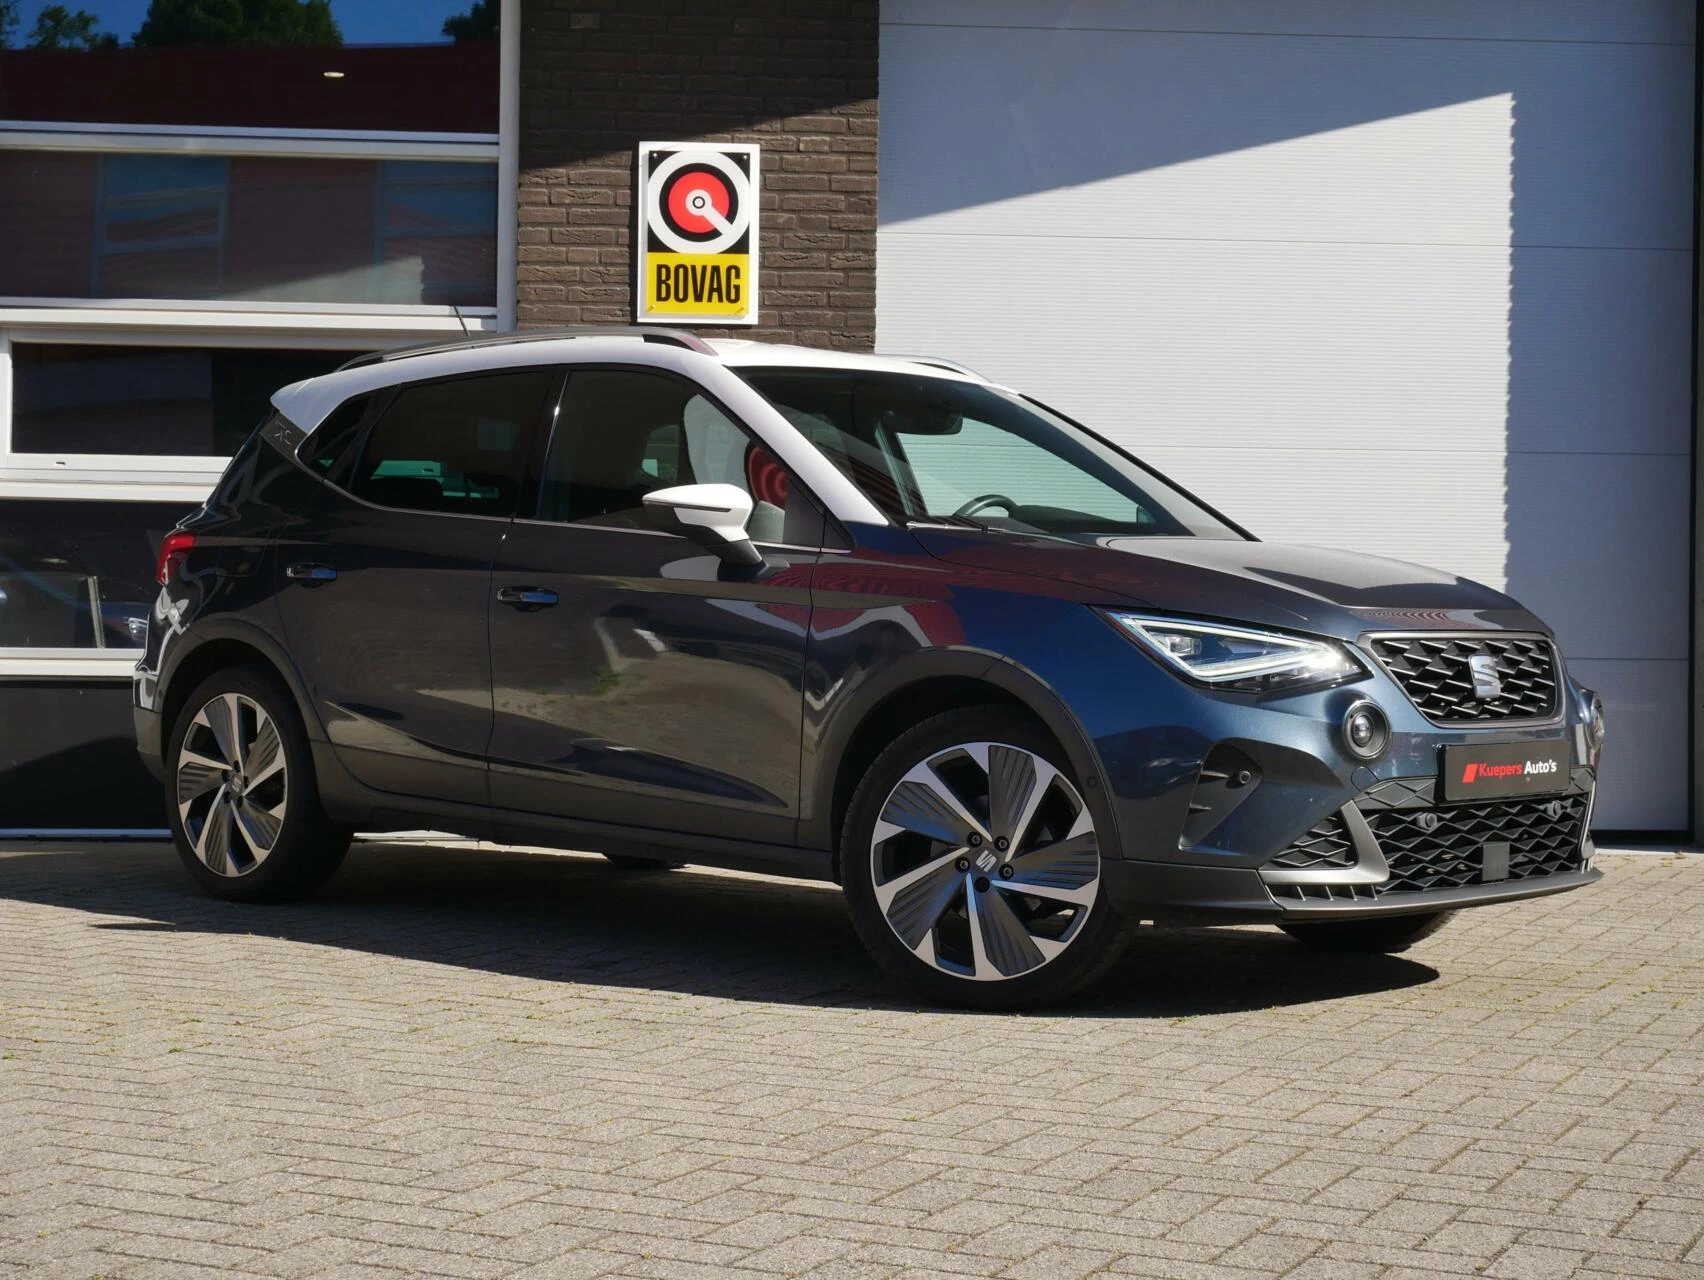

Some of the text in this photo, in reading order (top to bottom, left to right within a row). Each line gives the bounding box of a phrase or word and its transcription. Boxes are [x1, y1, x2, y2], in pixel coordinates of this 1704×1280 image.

[656, 263, 741, 304] BOVAG
[1478, 758, 1557, 779] Kuepers Auto's
